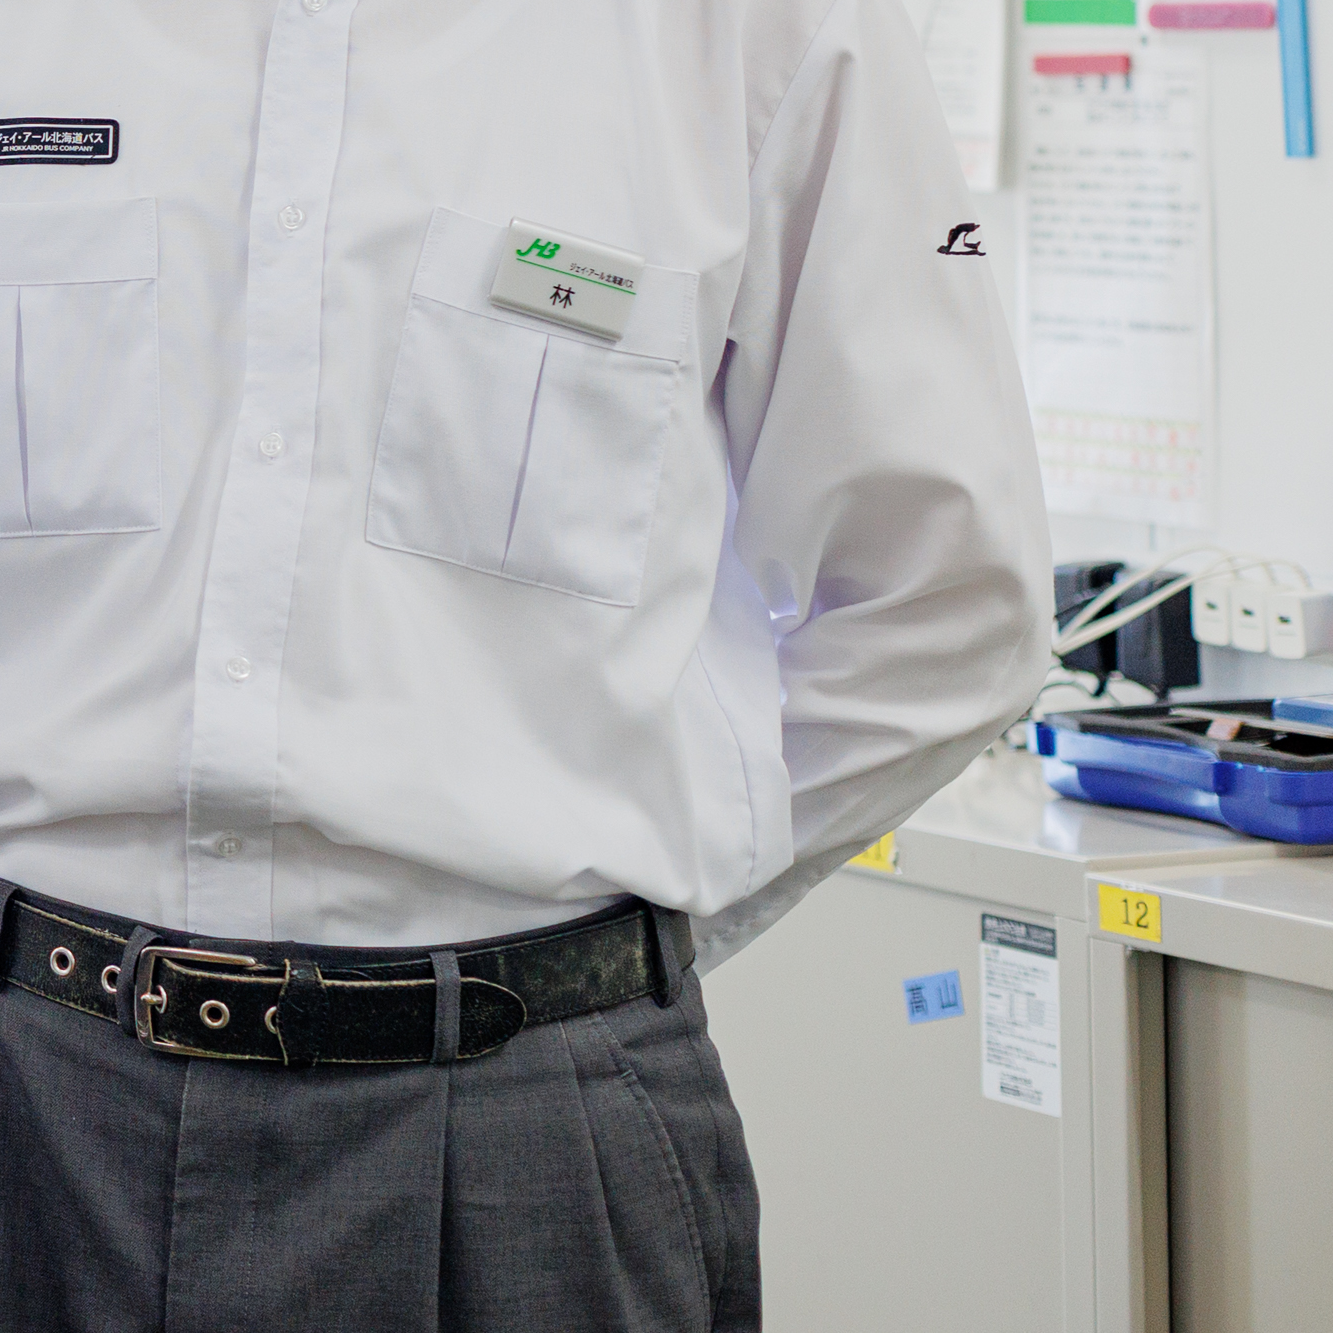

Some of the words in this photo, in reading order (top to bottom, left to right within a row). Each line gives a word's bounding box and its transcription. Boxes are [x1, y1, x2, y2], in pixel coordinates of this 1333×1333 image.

[58, 144, 94, 152] COMPANY
[550, 284, 575, 308] 林
[1119, 896, 1151, 930] 12
